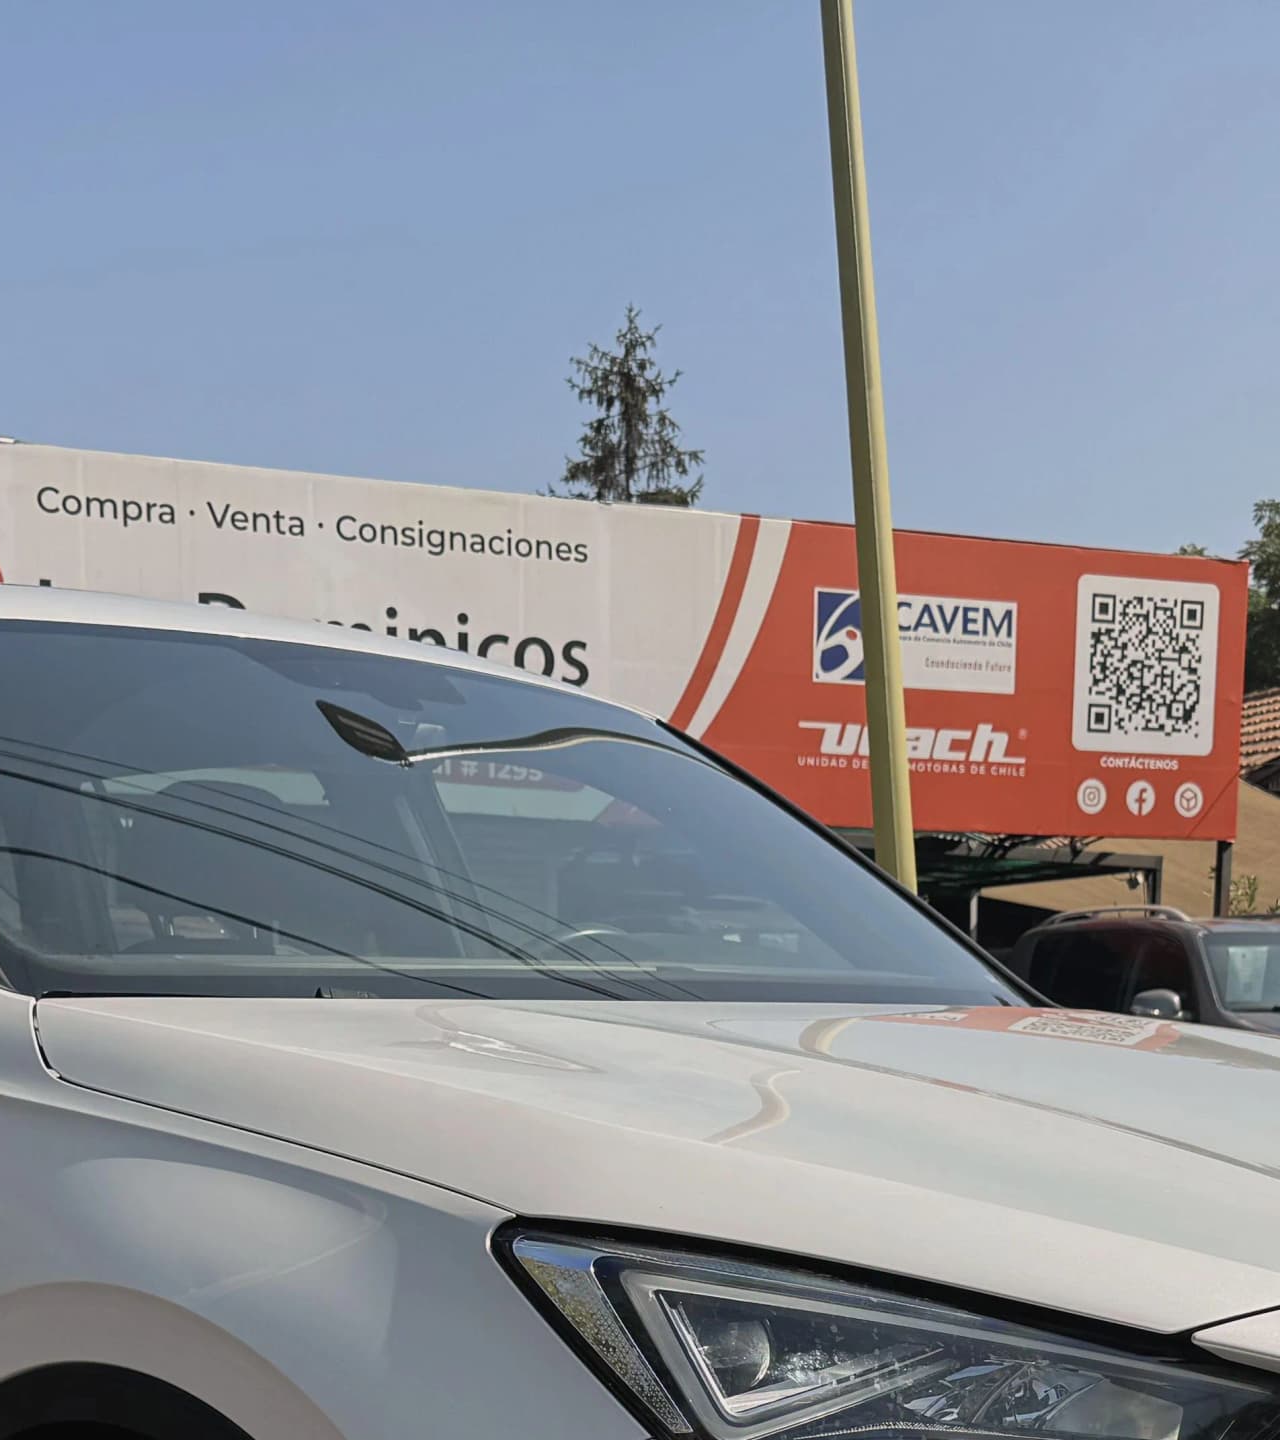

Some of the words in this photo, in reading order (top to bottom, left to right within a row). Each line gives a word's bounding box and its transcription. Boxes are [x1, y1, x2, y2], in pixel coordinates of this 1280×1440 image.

[36, 486, 176, 528] Compra
[206, 501, 305, 537] Venta
[335, 515, 588, 563] Consignaciones
[898, 601, 1013, 639] CAVEM
[796, 755, 848, 769] UNIDAD
[852, 758, 869, 770] DE
[970, 764, 986, 776] DE
[991, 765, 1026, 777] CHILE
[1100, 756, 1179, 770] CONTÁCTENOS
